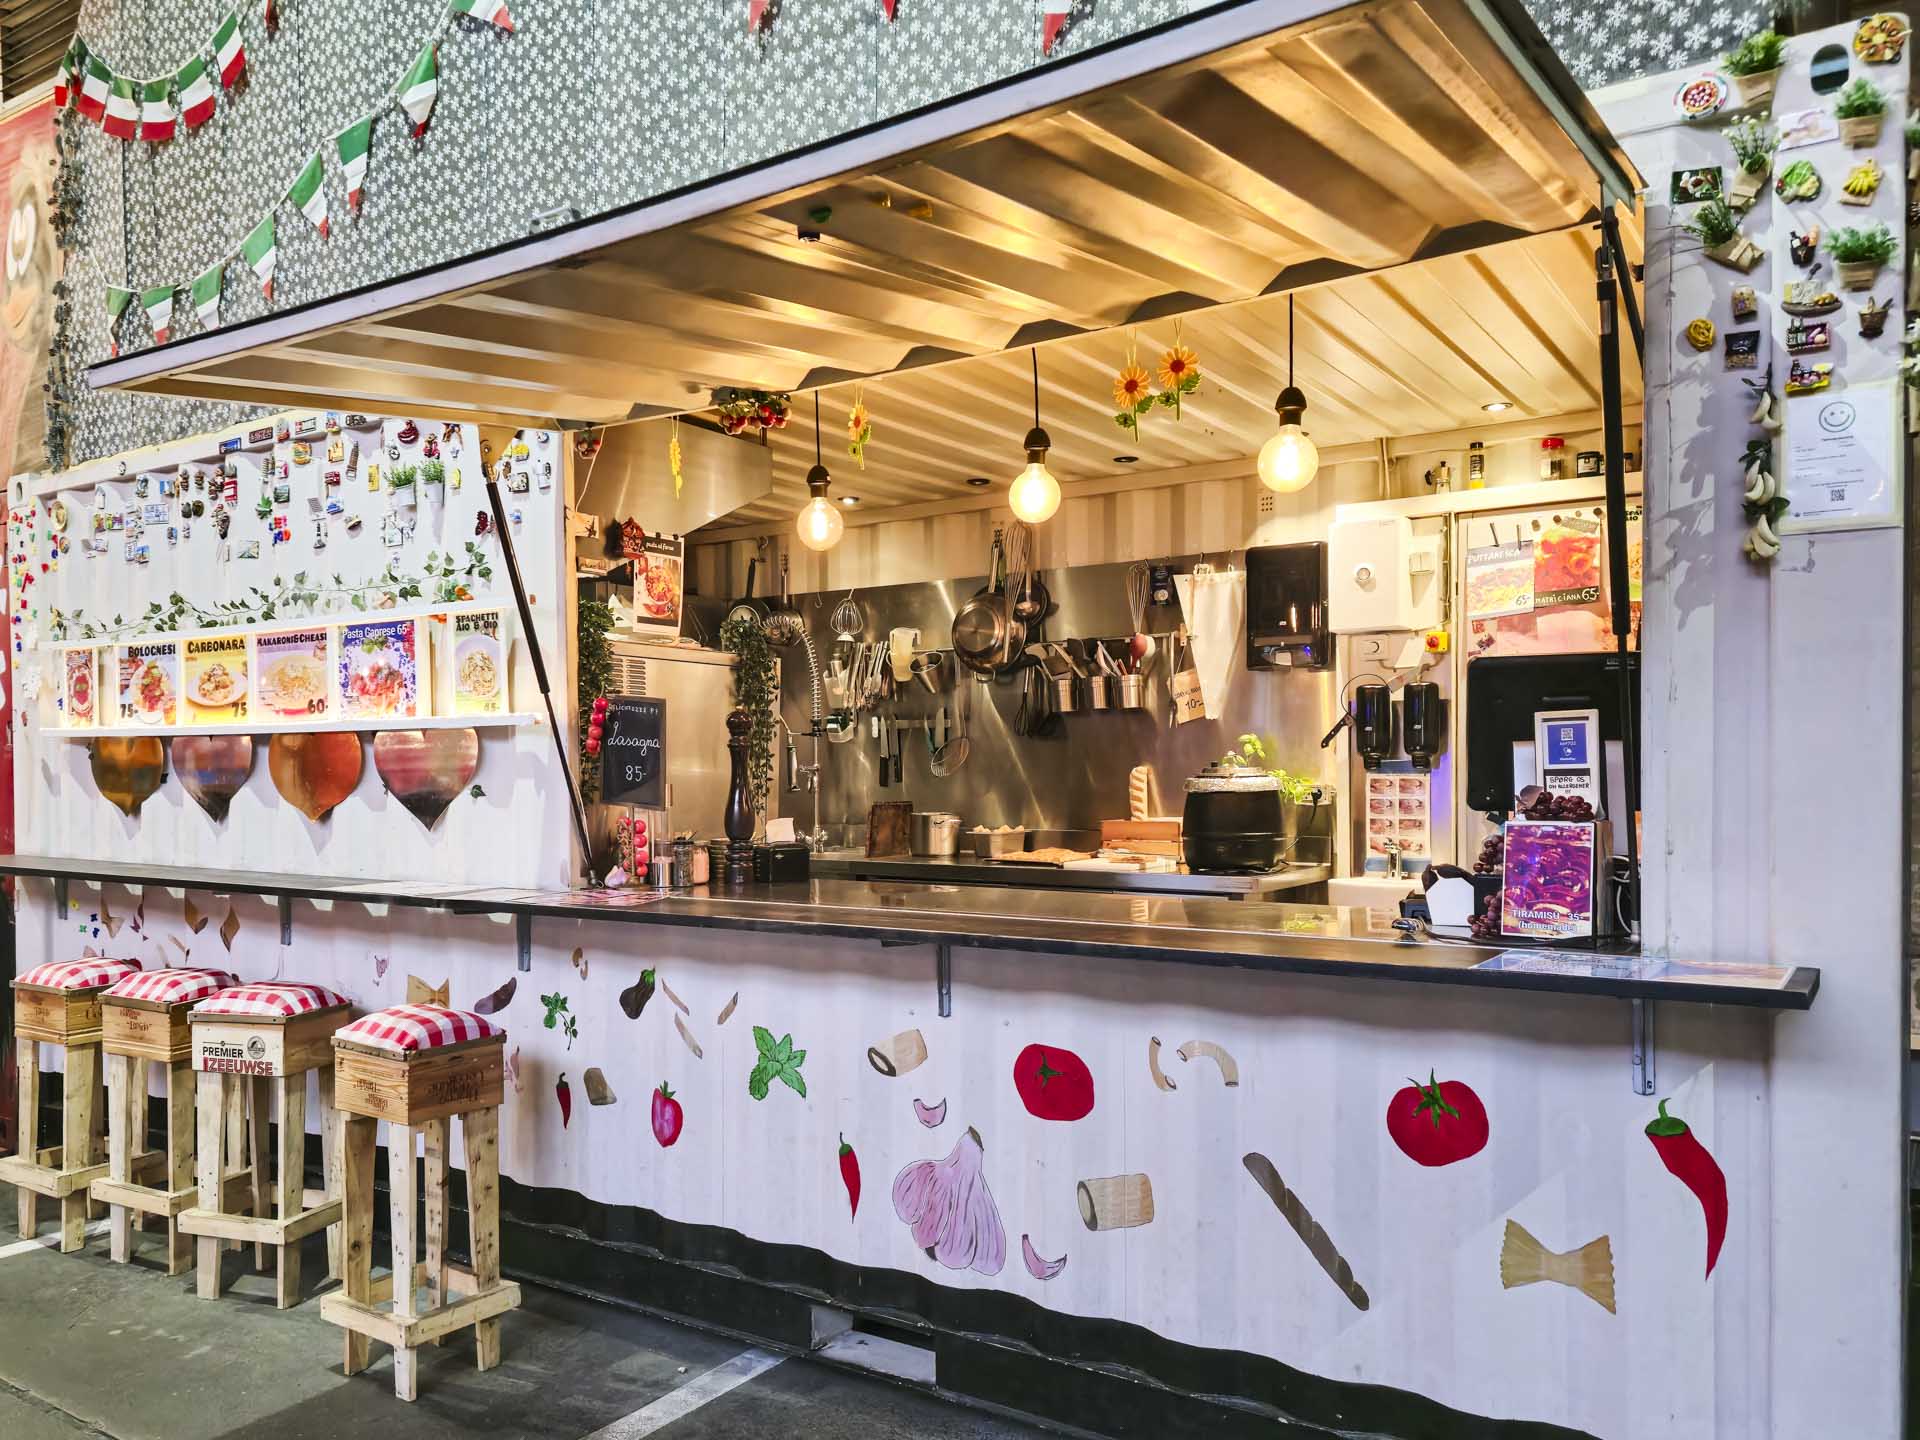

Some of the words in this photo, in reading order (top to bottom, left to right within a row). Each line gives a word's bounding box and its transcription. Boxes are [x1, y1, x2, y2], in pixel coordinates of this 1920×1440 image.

[343, 628, 363, 639] Pasta
[365, 626, 396, 641] Caprese
[188, 639, 245, 654] CARBONARA
[625, 765, 647, 782] 85-
[1512, 909, 1560, 920] TIRAMISU
[203, 1046, 244, 1059] PREMIER
